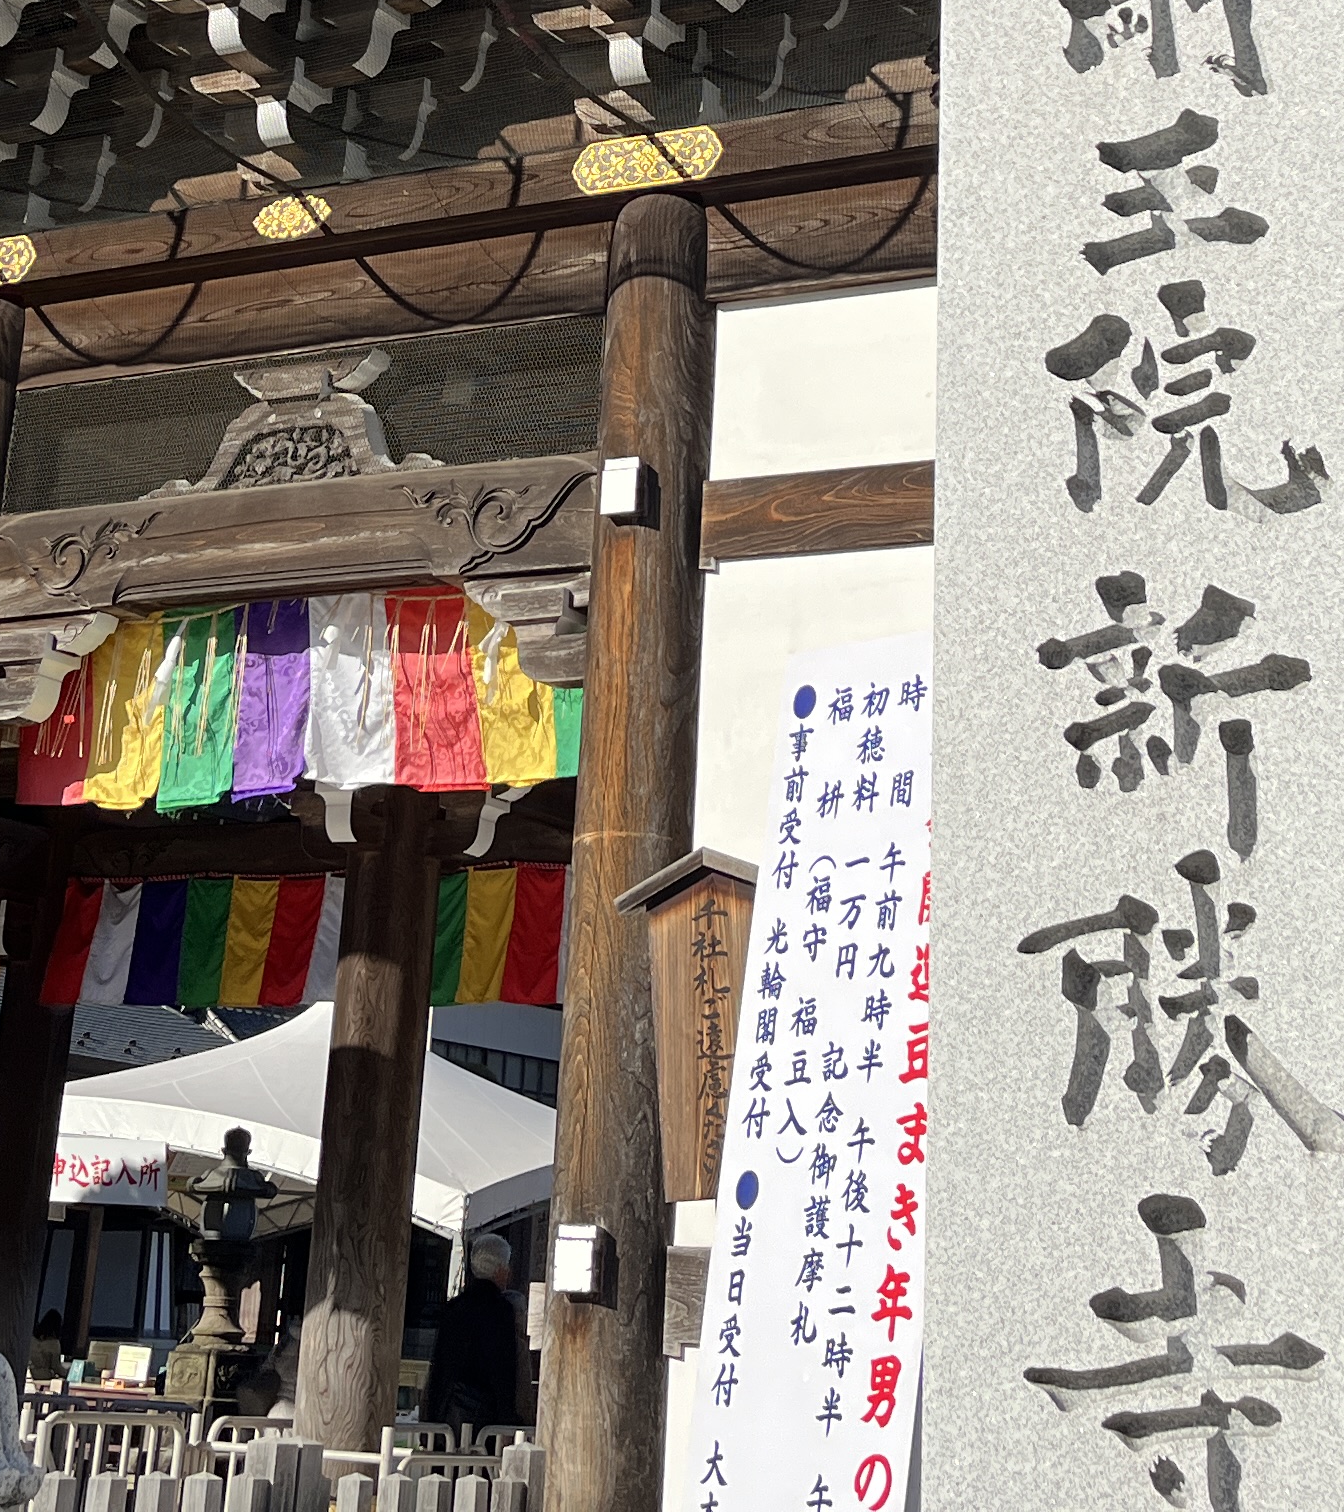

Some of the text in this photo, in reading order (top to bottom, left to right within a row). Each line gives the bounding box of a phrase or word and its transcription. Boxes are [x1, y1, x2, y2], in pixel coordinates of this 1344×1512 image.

[771, 724, 815, 890] 事前受付
[889, 673, 928, 807] 時間
[790, 681, 890, 1346] 初穂料 一万円 記念御護摩札
[856, 842, 906, 1083] 午前九時半
[710, 1216, 752, 1408] 当日受付
[815, 1116, 876, 1437] 午後十二時半
